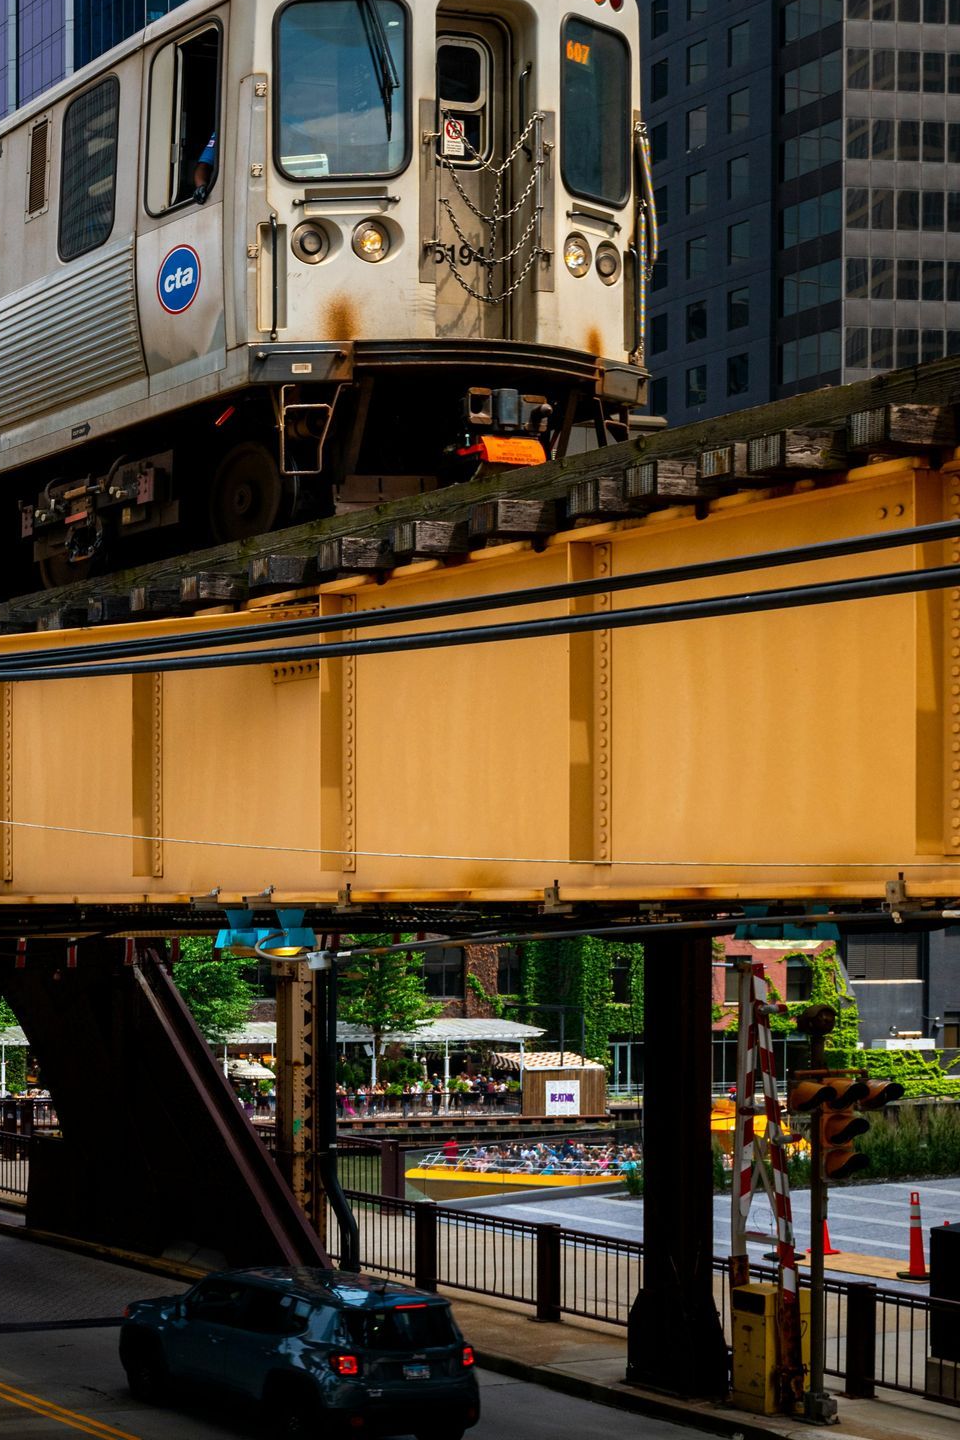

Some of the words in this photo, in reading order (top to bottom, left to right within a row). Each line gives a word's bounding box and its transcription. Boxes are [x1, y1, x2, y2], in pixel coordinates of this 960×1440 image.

[566, 40, 590, 64] 607
[434, 243, 485, 267] 5194
[164, 266, 193, 293] cta
